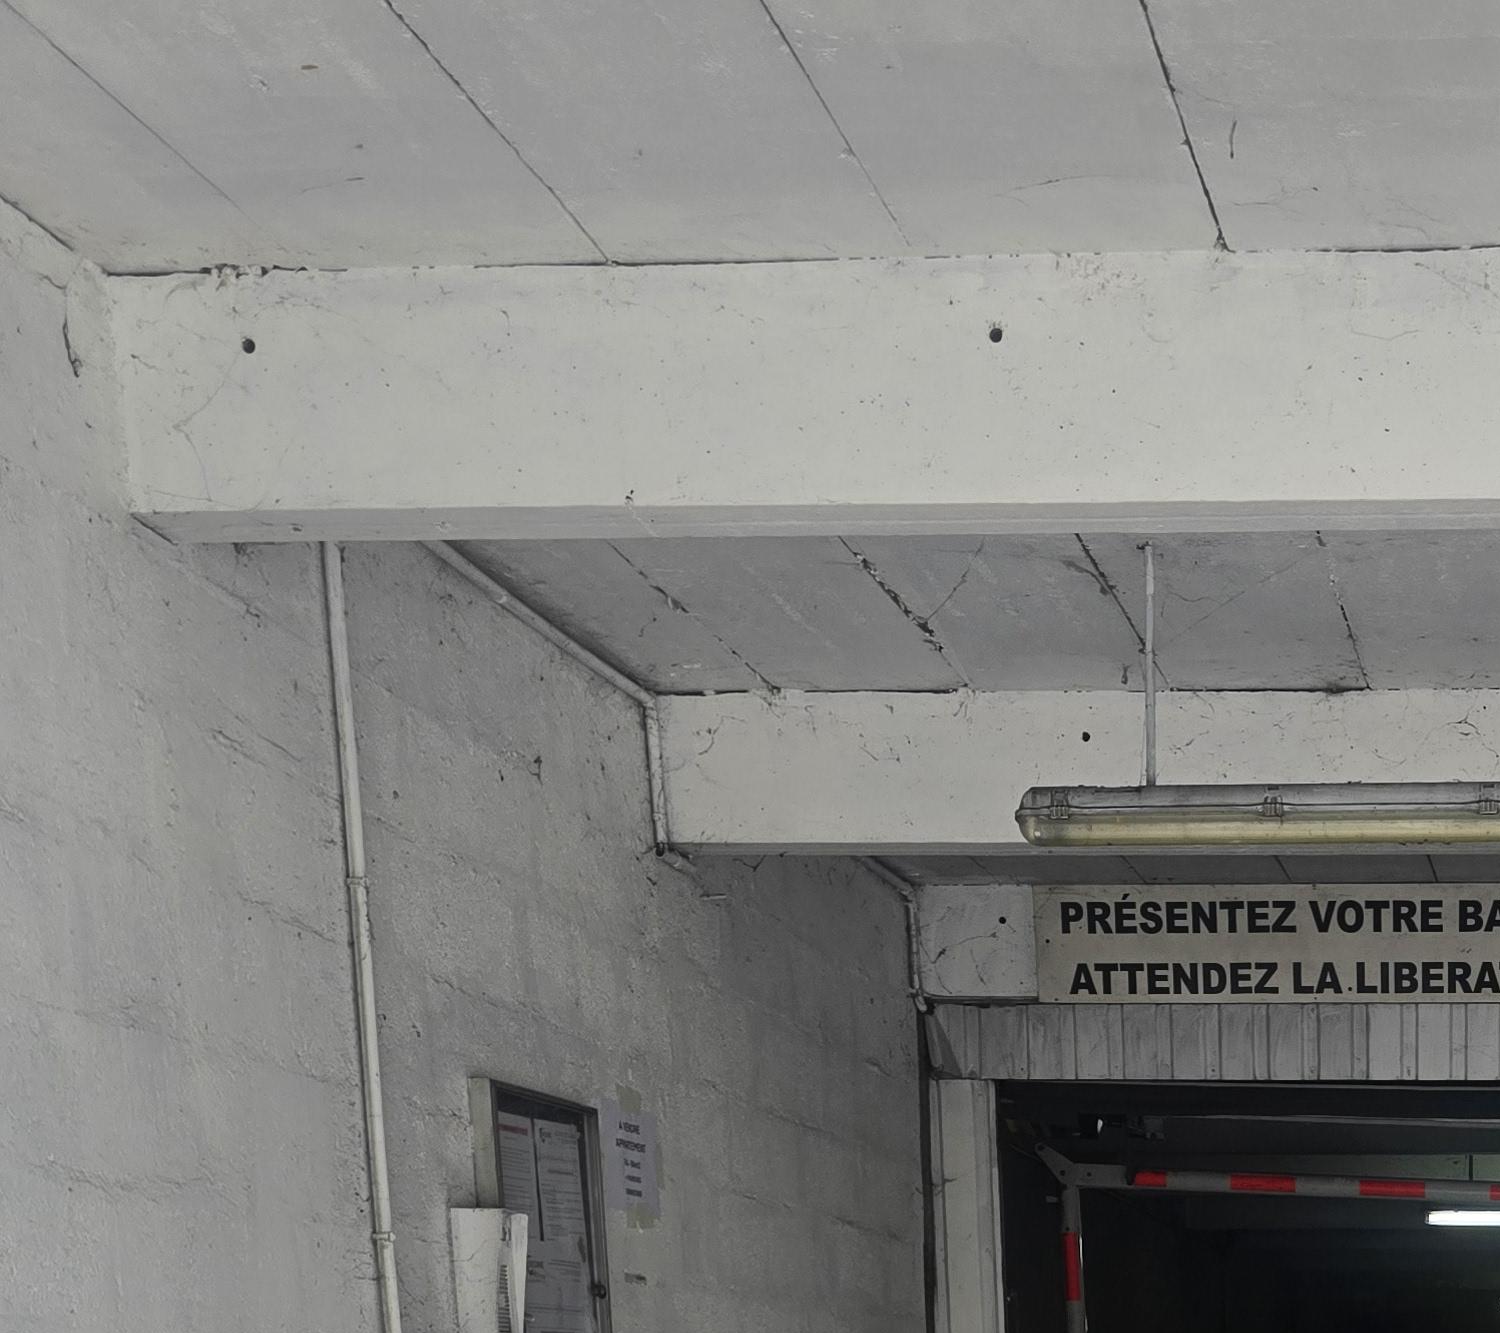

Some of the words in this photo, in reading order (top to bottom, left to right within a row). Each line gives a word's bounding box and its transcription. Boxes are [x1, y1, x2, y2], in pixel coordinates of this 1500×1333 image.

[1060, 893, 1297, 935] PRÉSENTEZ
[1308, 899, 1444, 934] VOTRE
[1069, 962, 1280, 996] ATTENDEZ
[1292, 961, 1344, 995] LA
